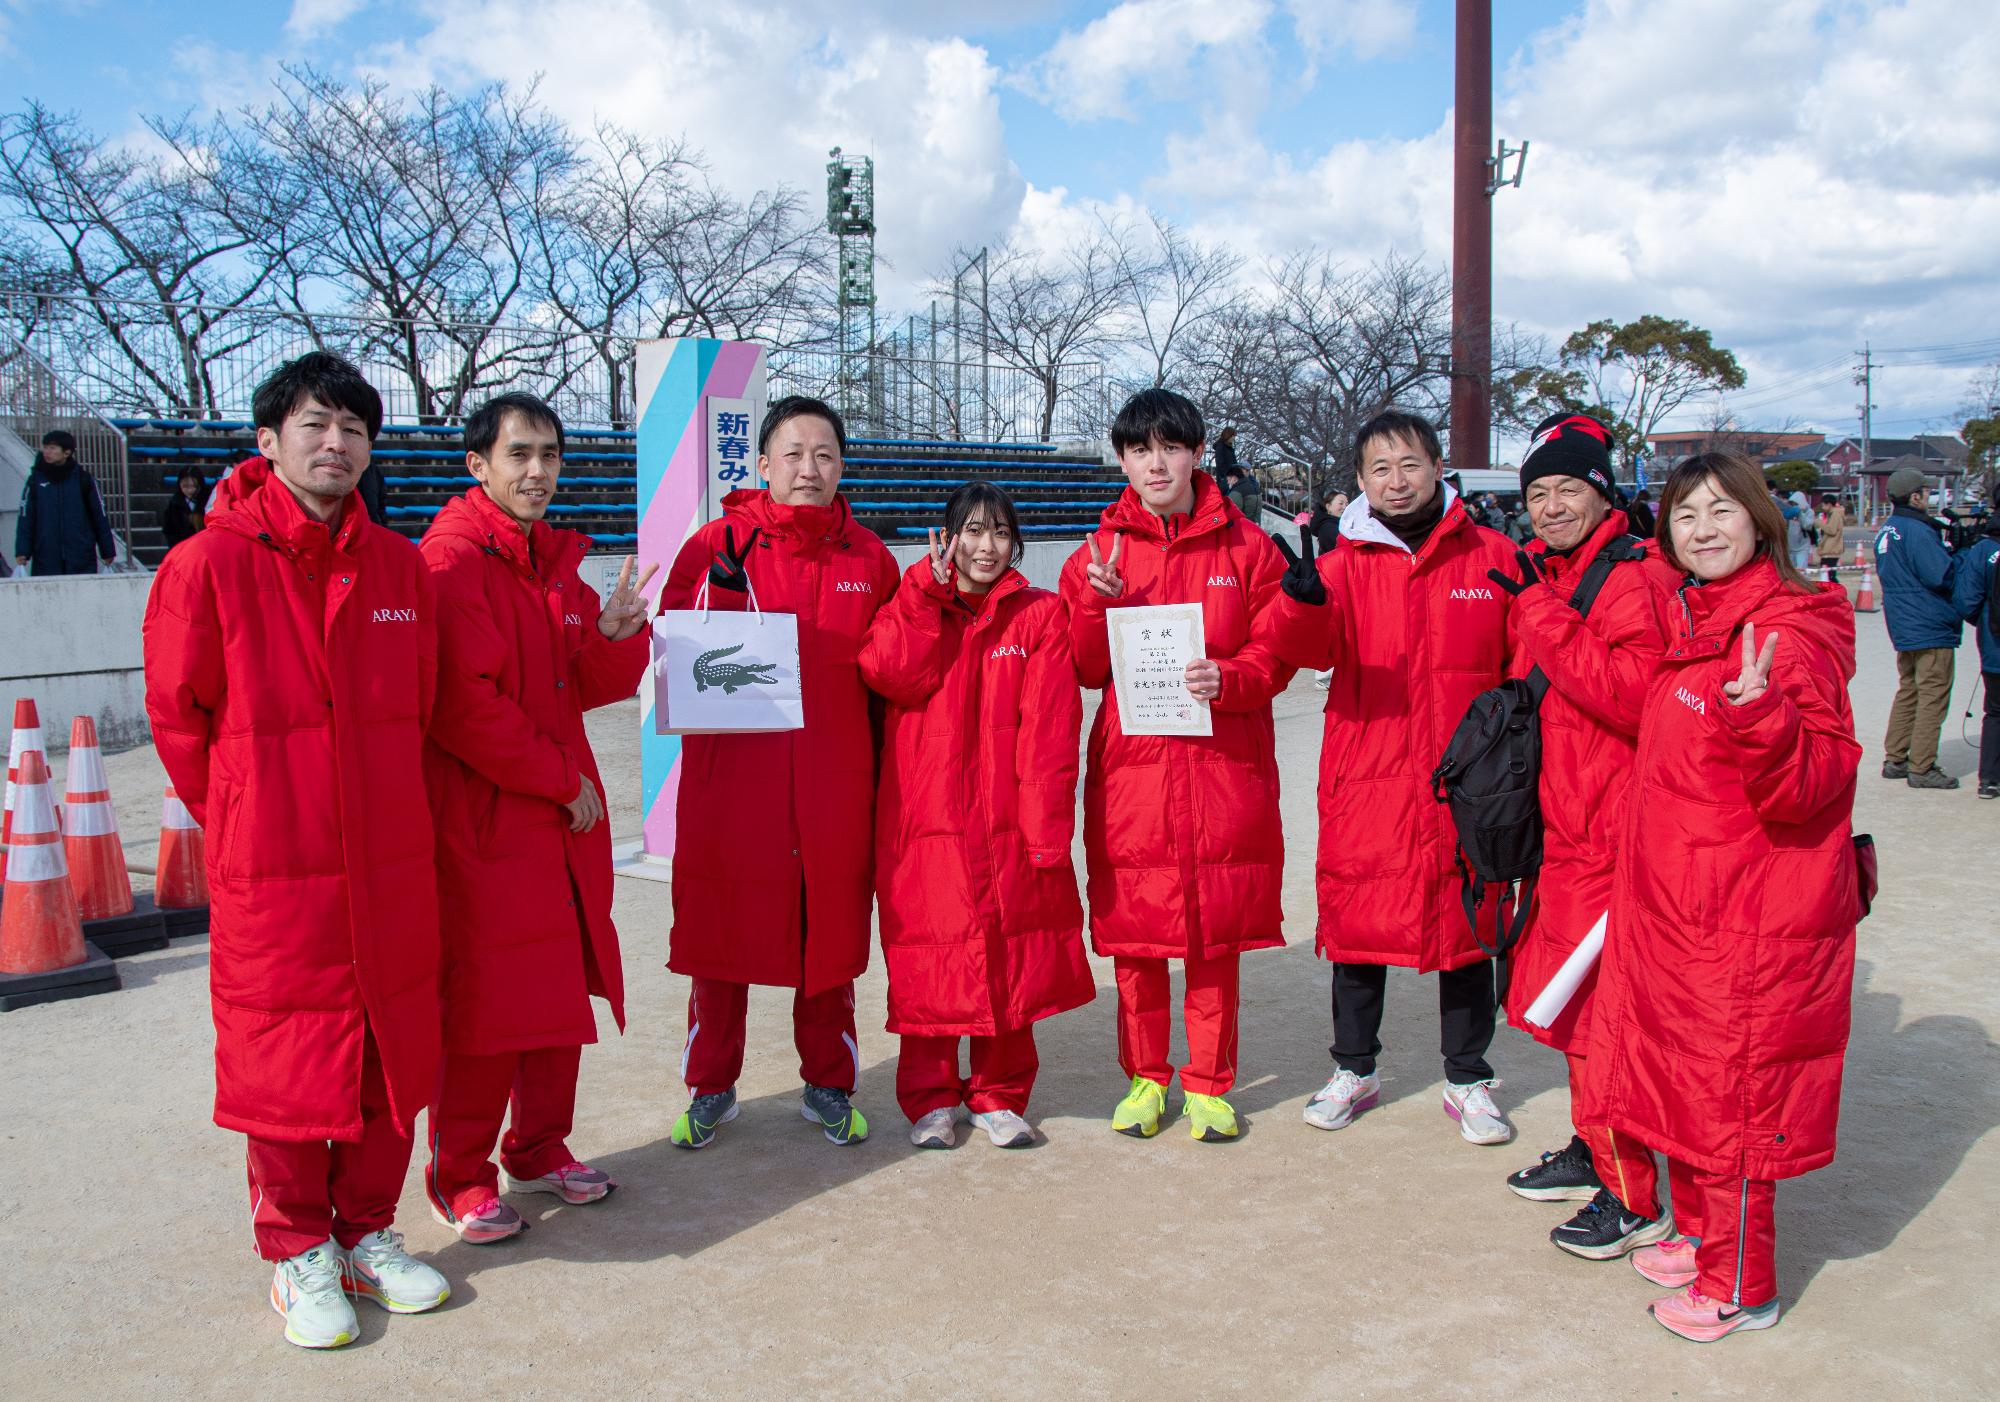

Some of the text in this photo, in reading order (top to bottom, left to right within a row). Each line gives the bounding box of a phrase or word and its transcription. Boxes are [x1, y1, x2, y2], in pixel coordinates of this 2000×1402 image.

[716, 411, 750, 502] 新春み
[835, 581, 872, 594] ARAYA
[1206, 575, 1239, 587] ARAY
[1450, 588, 1493, 600] ARAYA
[372, 608, 418, 623] ARAYA
[1674, 685, 1705, 716] ARAYA
